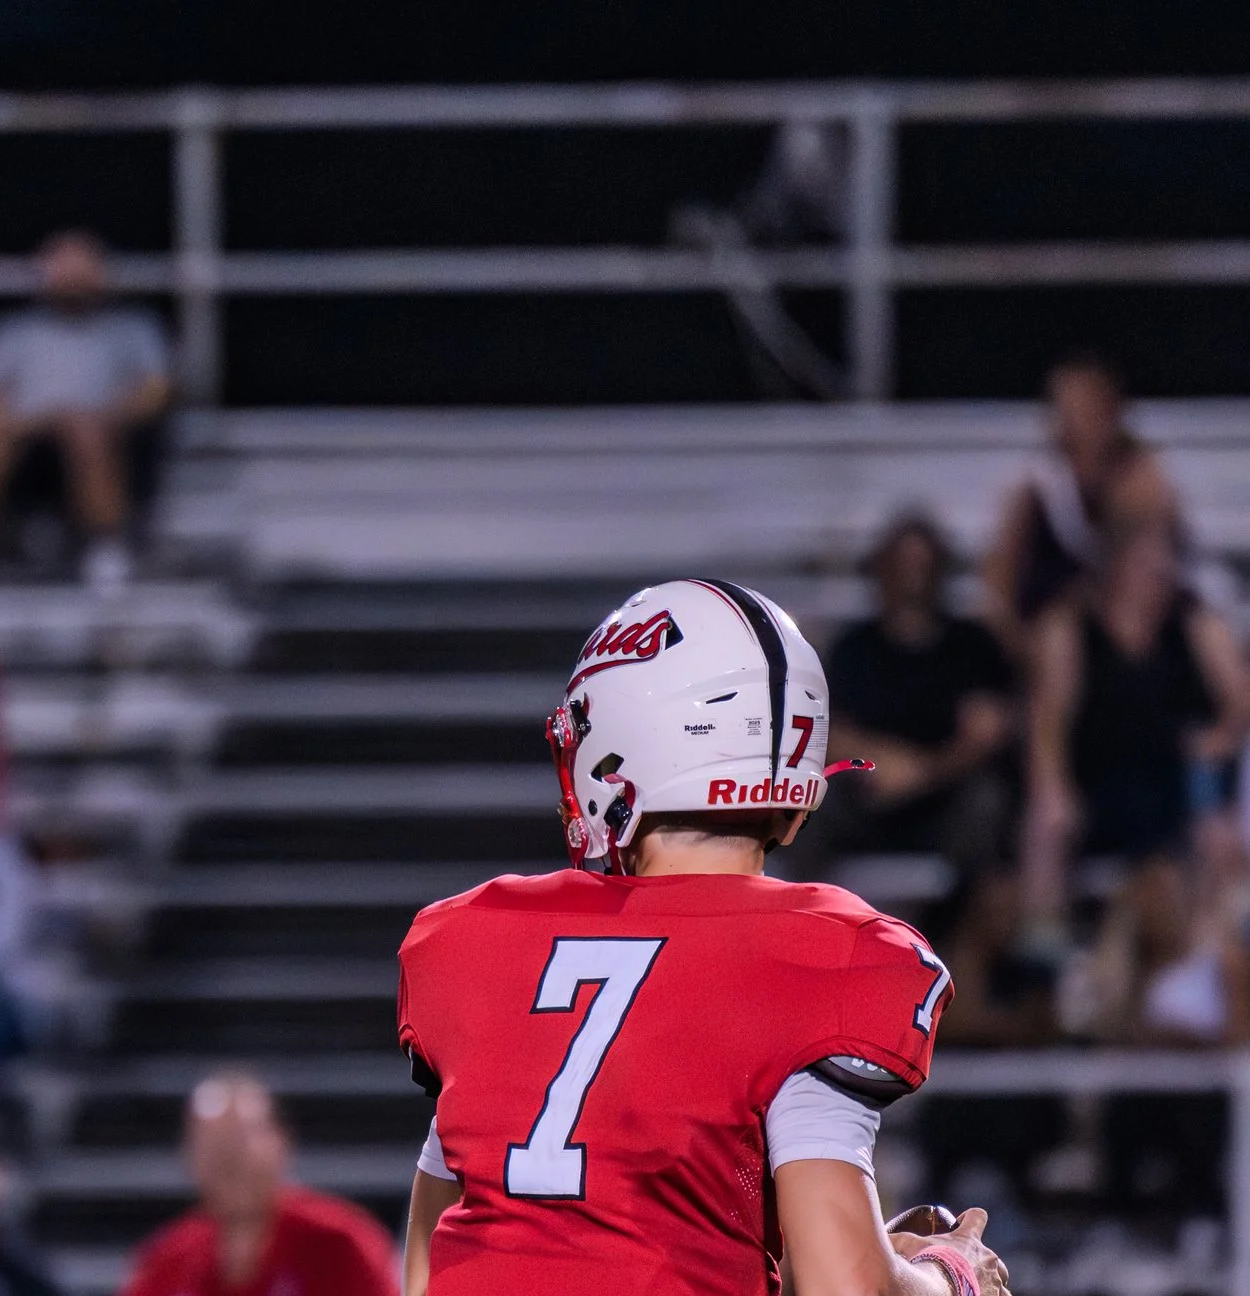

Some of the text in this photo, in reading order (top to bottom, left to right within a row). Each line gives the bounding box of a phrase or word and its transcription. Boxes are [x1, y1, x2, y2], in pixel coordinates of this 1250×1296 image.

[684, 723, 713, 732] Riddell
[785, 714, 814, 769] 7
[707, 777, 819, 807] Riddell
[910, 942, 951, 1041] 7
[503, 936, 669, 1201] 7
